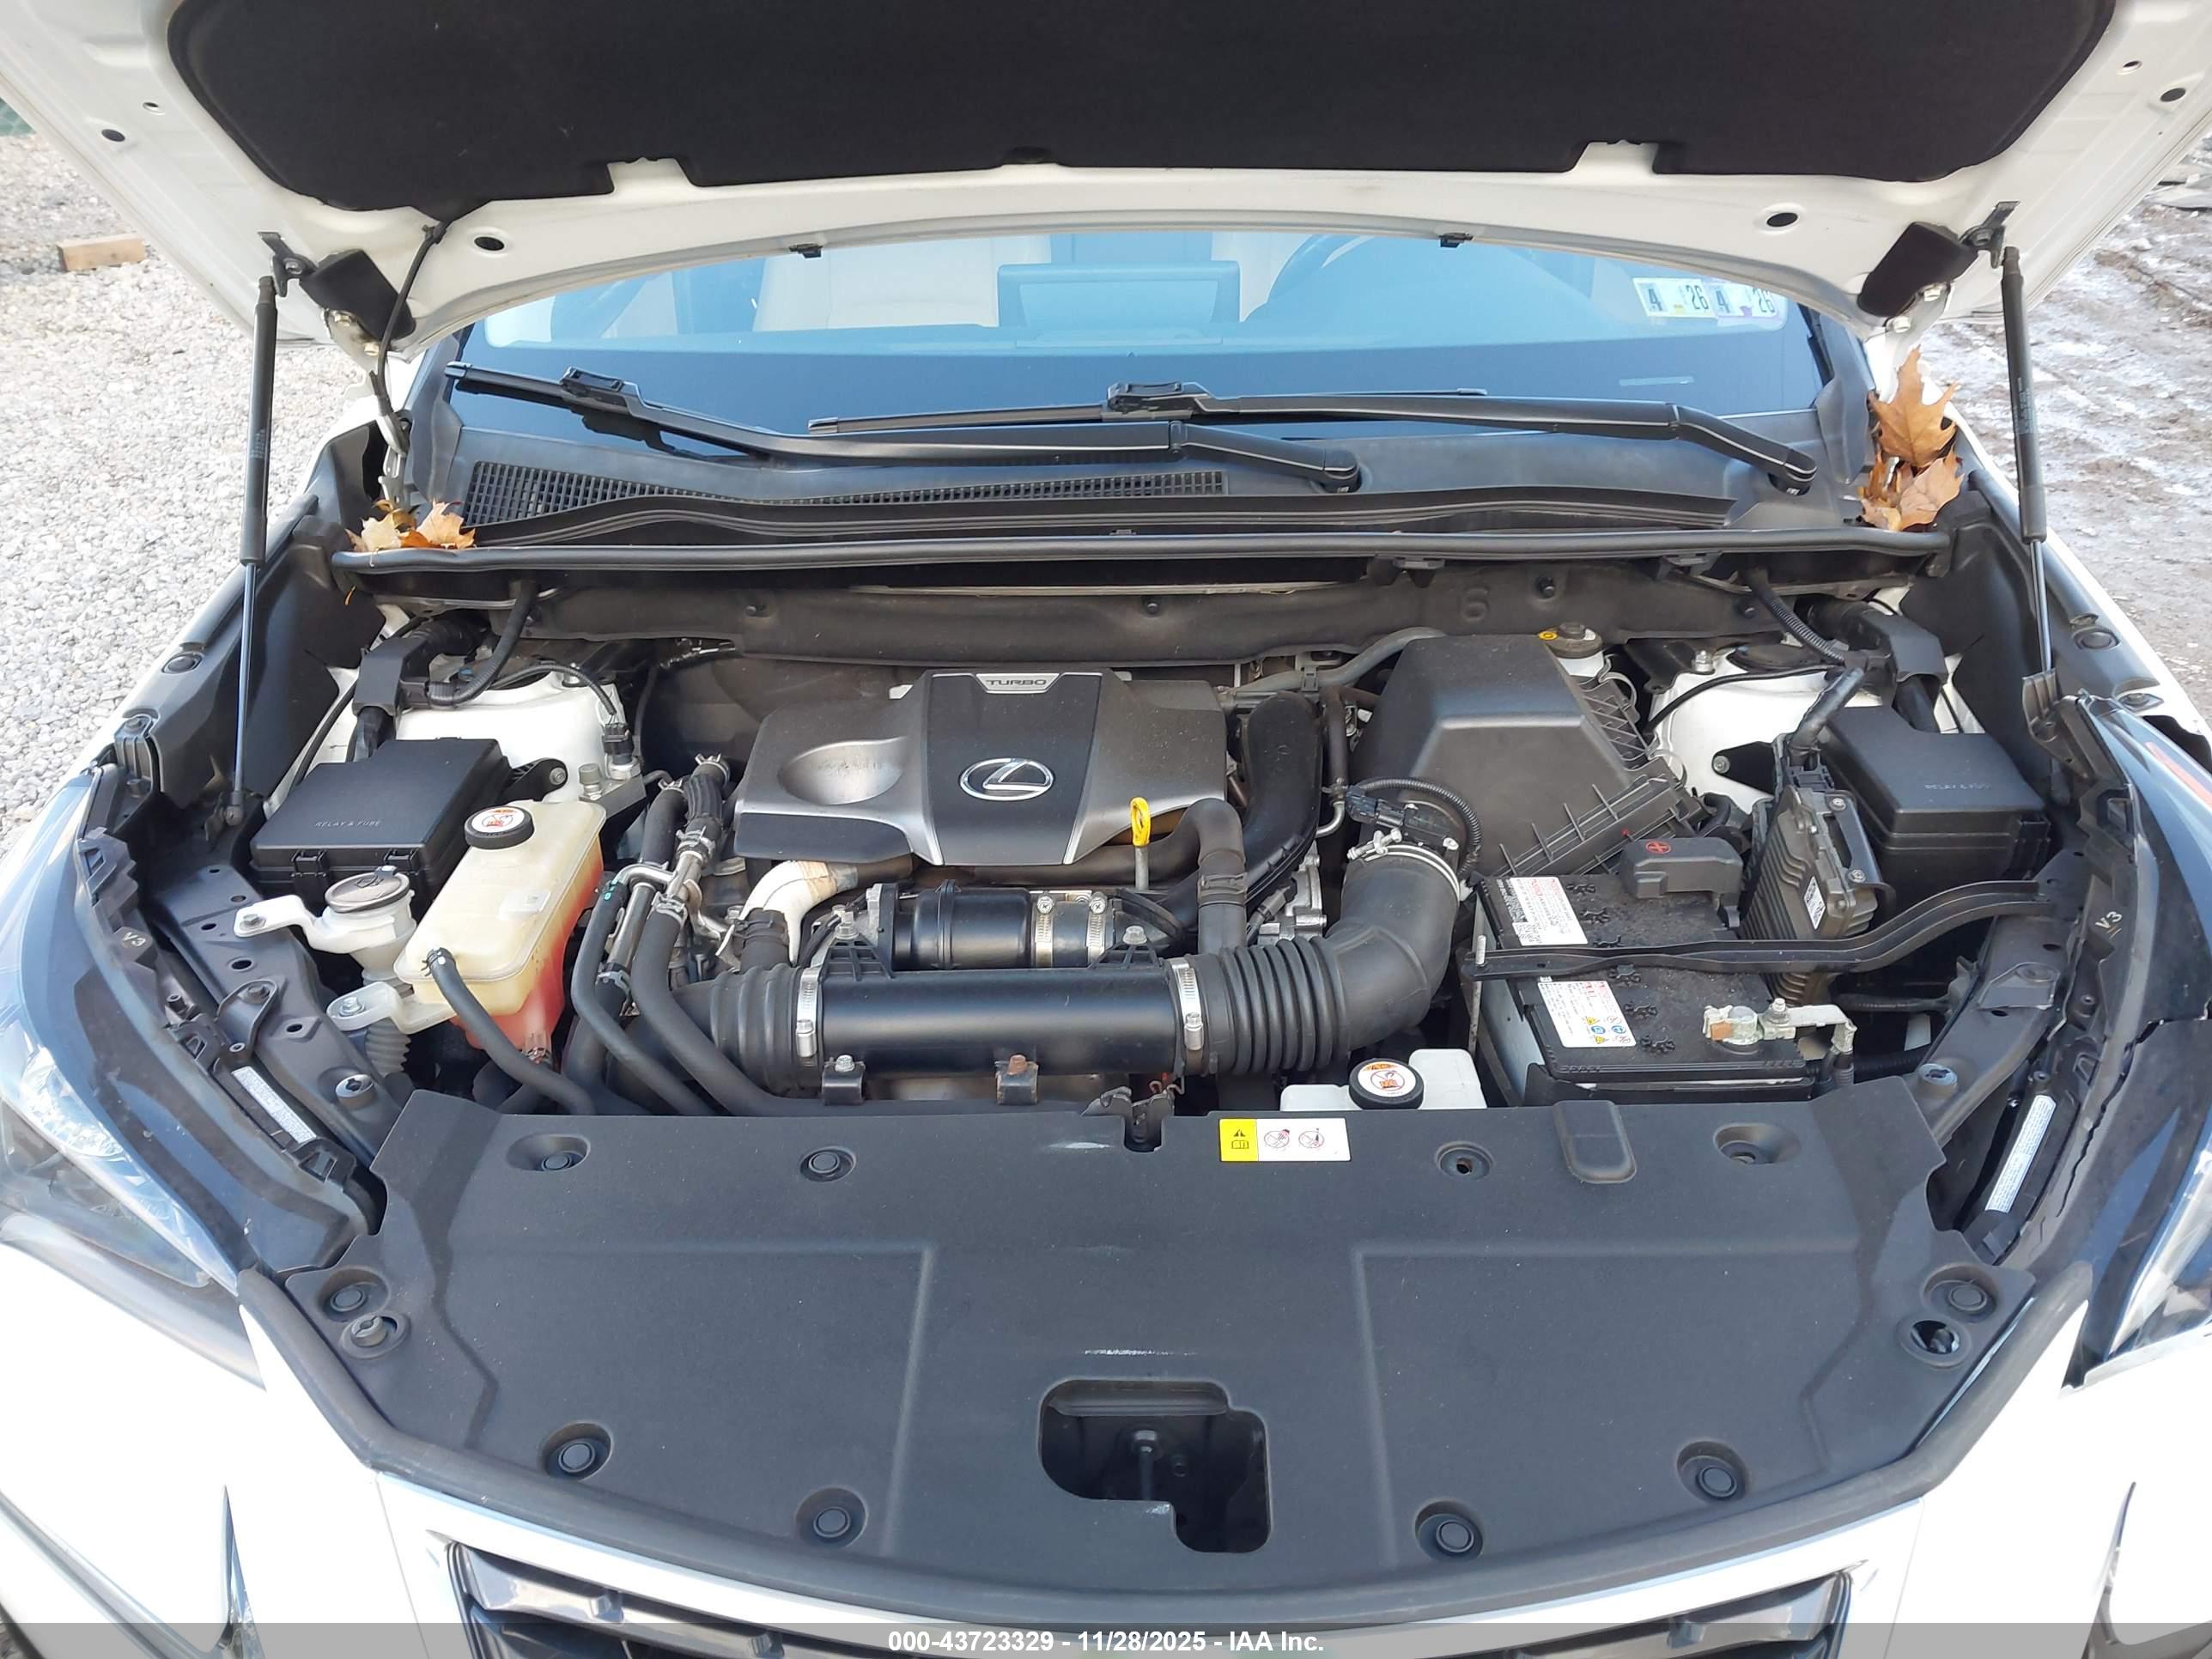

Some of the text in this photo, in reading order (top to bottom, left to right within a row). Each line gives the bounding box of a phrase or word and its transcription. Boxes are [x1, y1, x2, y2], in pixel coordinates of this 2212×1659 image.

[1647, 284, 1710, 311] 4 26
[1715, 289, 1731, 313] 4
[2094, 910, 2123, 929] V3
